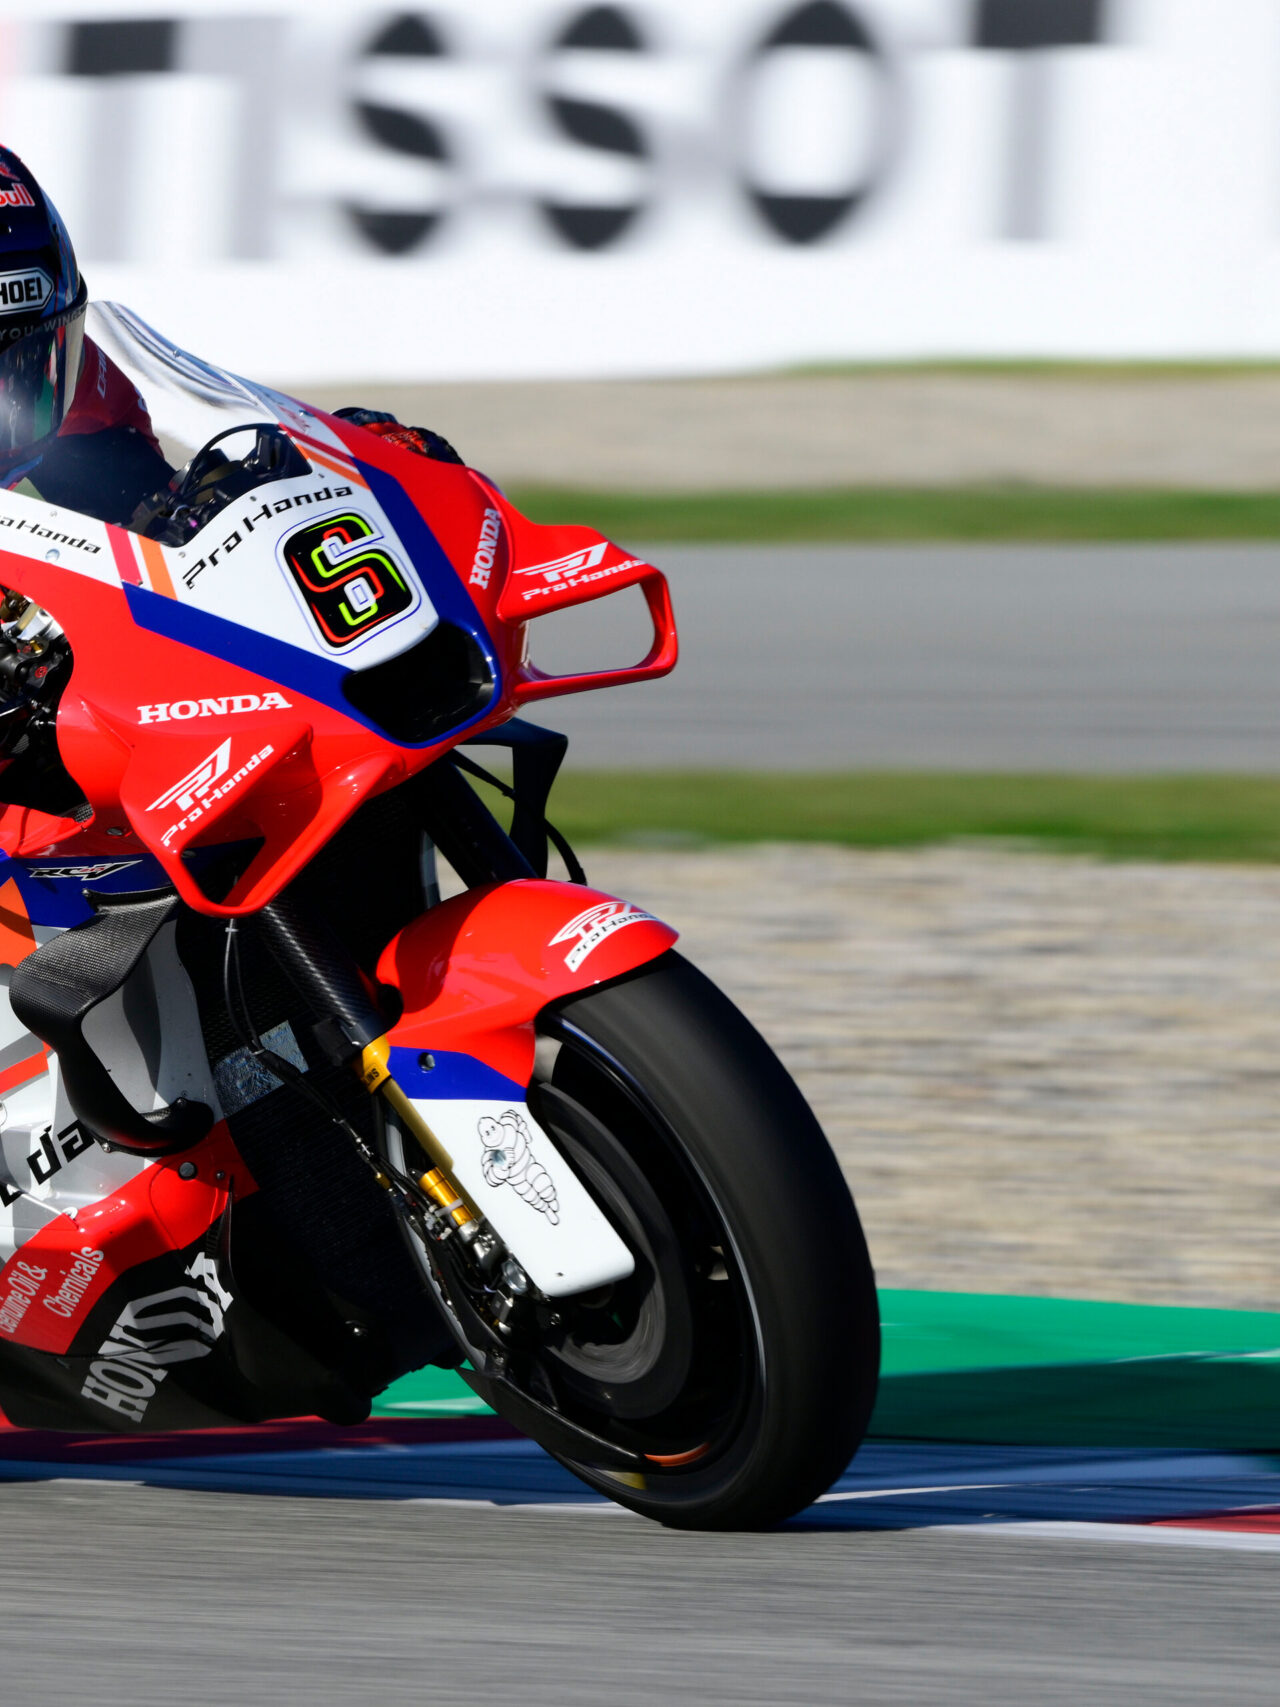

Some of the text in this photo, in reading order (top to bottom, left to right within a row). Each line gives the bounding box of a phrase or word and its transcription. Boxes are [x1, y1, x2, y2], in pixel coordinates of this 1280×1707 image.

[30, 0, 1125, 263] TISSOT
[282, 511, 414, 649] 6
[468, 507, 502, 591] HONDA
[136, 691, 293, 725] HONDA
[7, 1269, 41, 1297] Oil
[16, 1260, 48, 1281] &
[42, 1246, 105, 1318] Chemicals
[80, 1251, 234, 1424] HONDA
